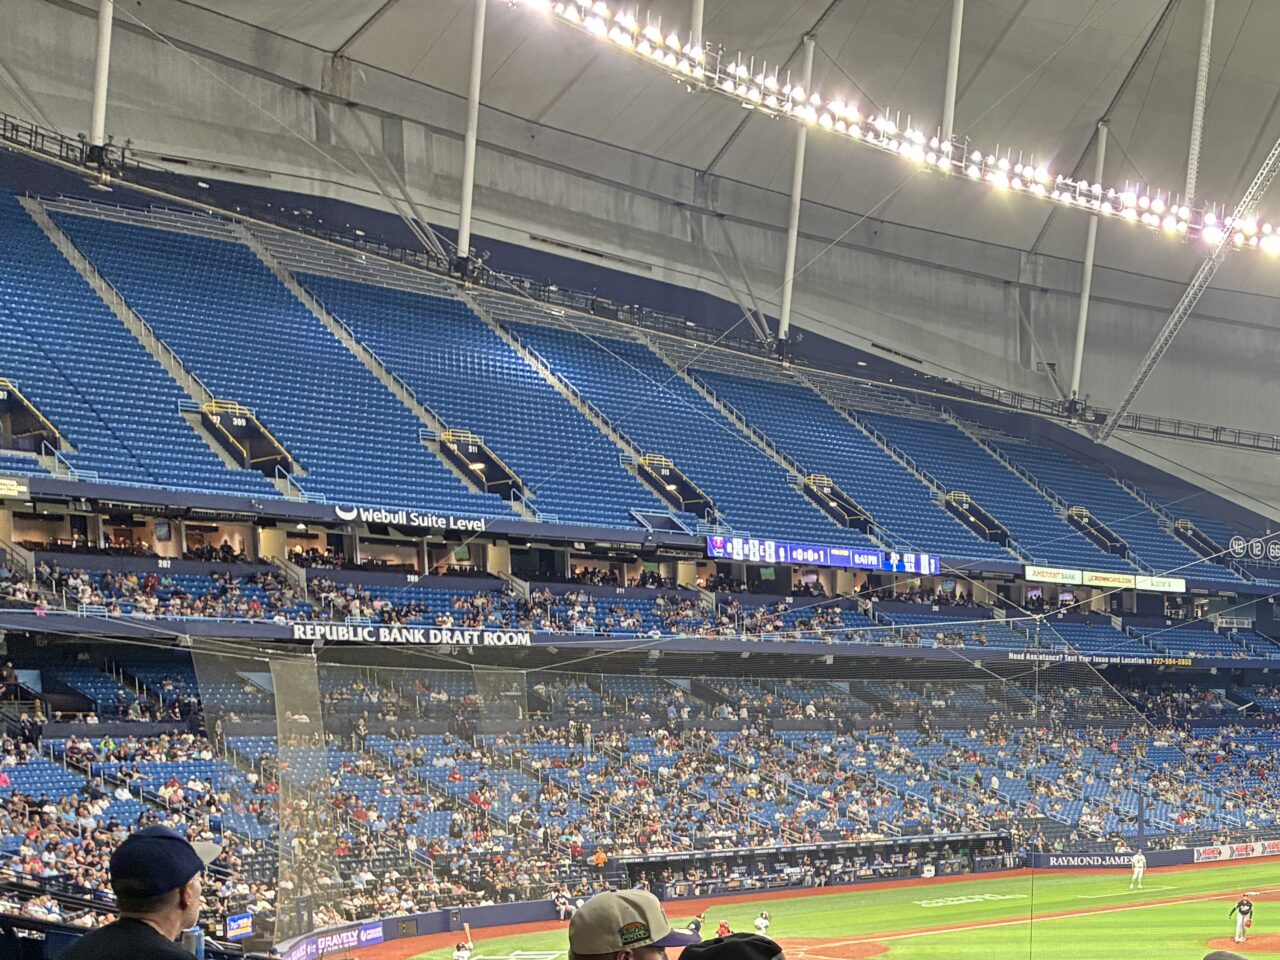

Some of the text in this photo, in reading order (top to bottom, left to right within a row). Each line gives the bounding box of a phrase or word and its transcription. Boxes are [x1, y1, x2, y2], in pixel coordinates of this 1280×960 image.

[360, 508, 485, 532] Webull Suite Level
[1232, 540, 1280, 556] 42 12 66
[158, 560, 171, 569] 207
[293, 623, 531, 646] REPUBLIC BANK DRAFT ROOM
[1050, 856, 1101, 867] RAYMOND
[318, 930, 358, 949] GRAVELY
